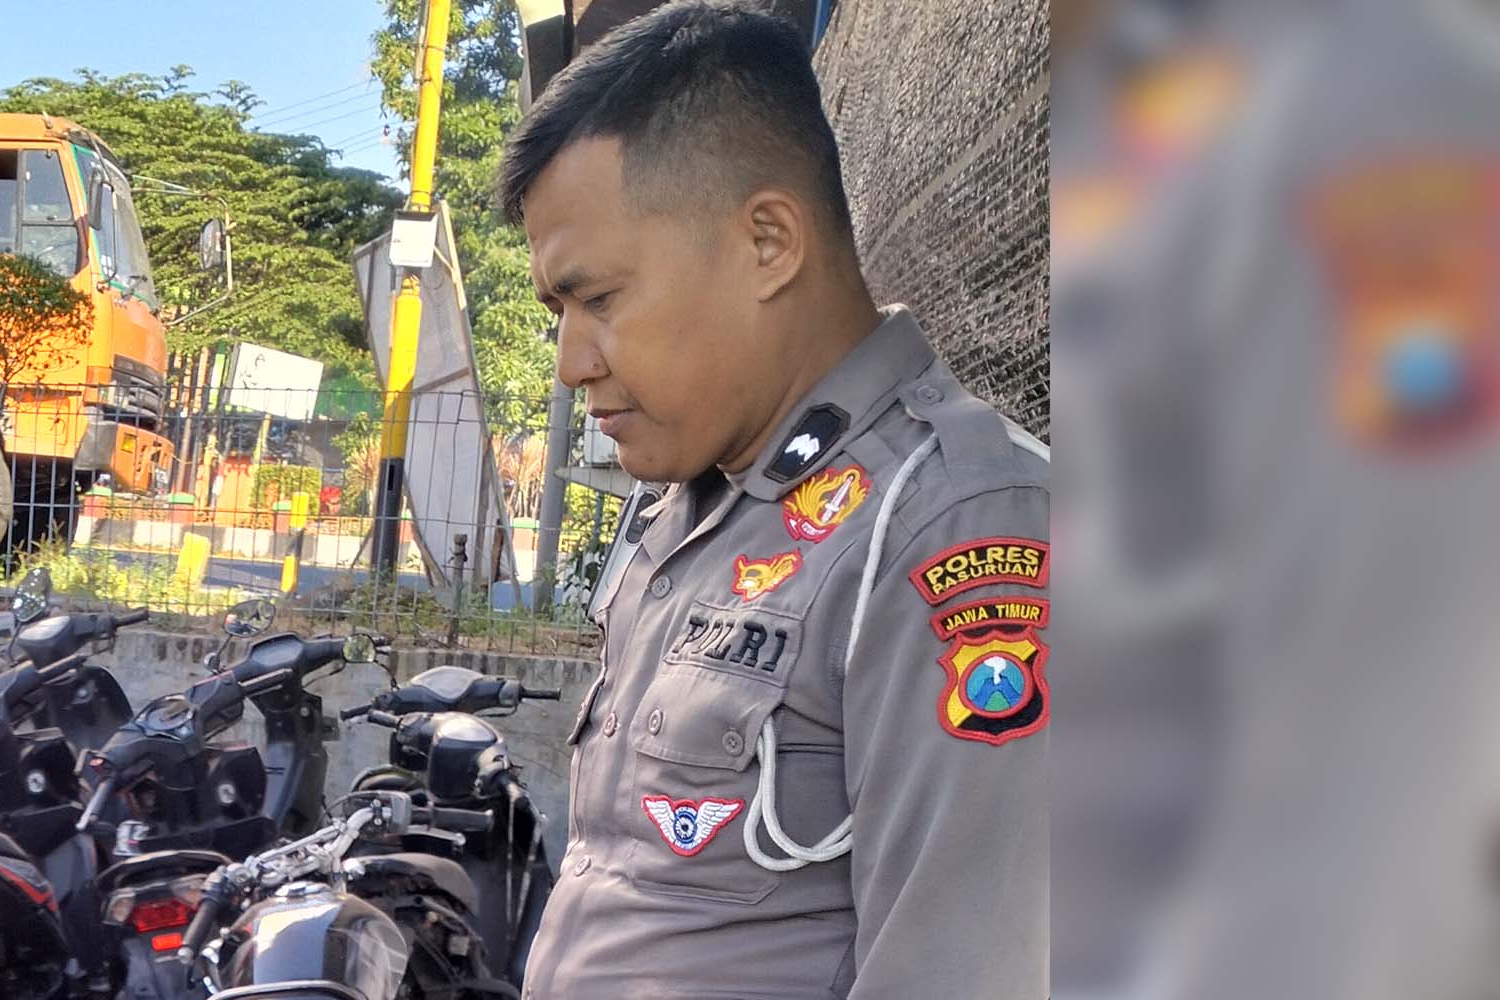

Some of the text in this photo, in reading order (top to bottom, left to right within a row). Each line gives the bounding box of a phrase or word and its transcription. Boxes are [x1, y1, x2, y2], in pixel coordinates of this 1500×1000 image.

[926, 546, 1039, 585] POLRES
[932, 563, 1038, 595] PASURUAN
[946, 604, 1040, 630] JAWA TIMUR
[671, 616, 787, 673] POLRI
